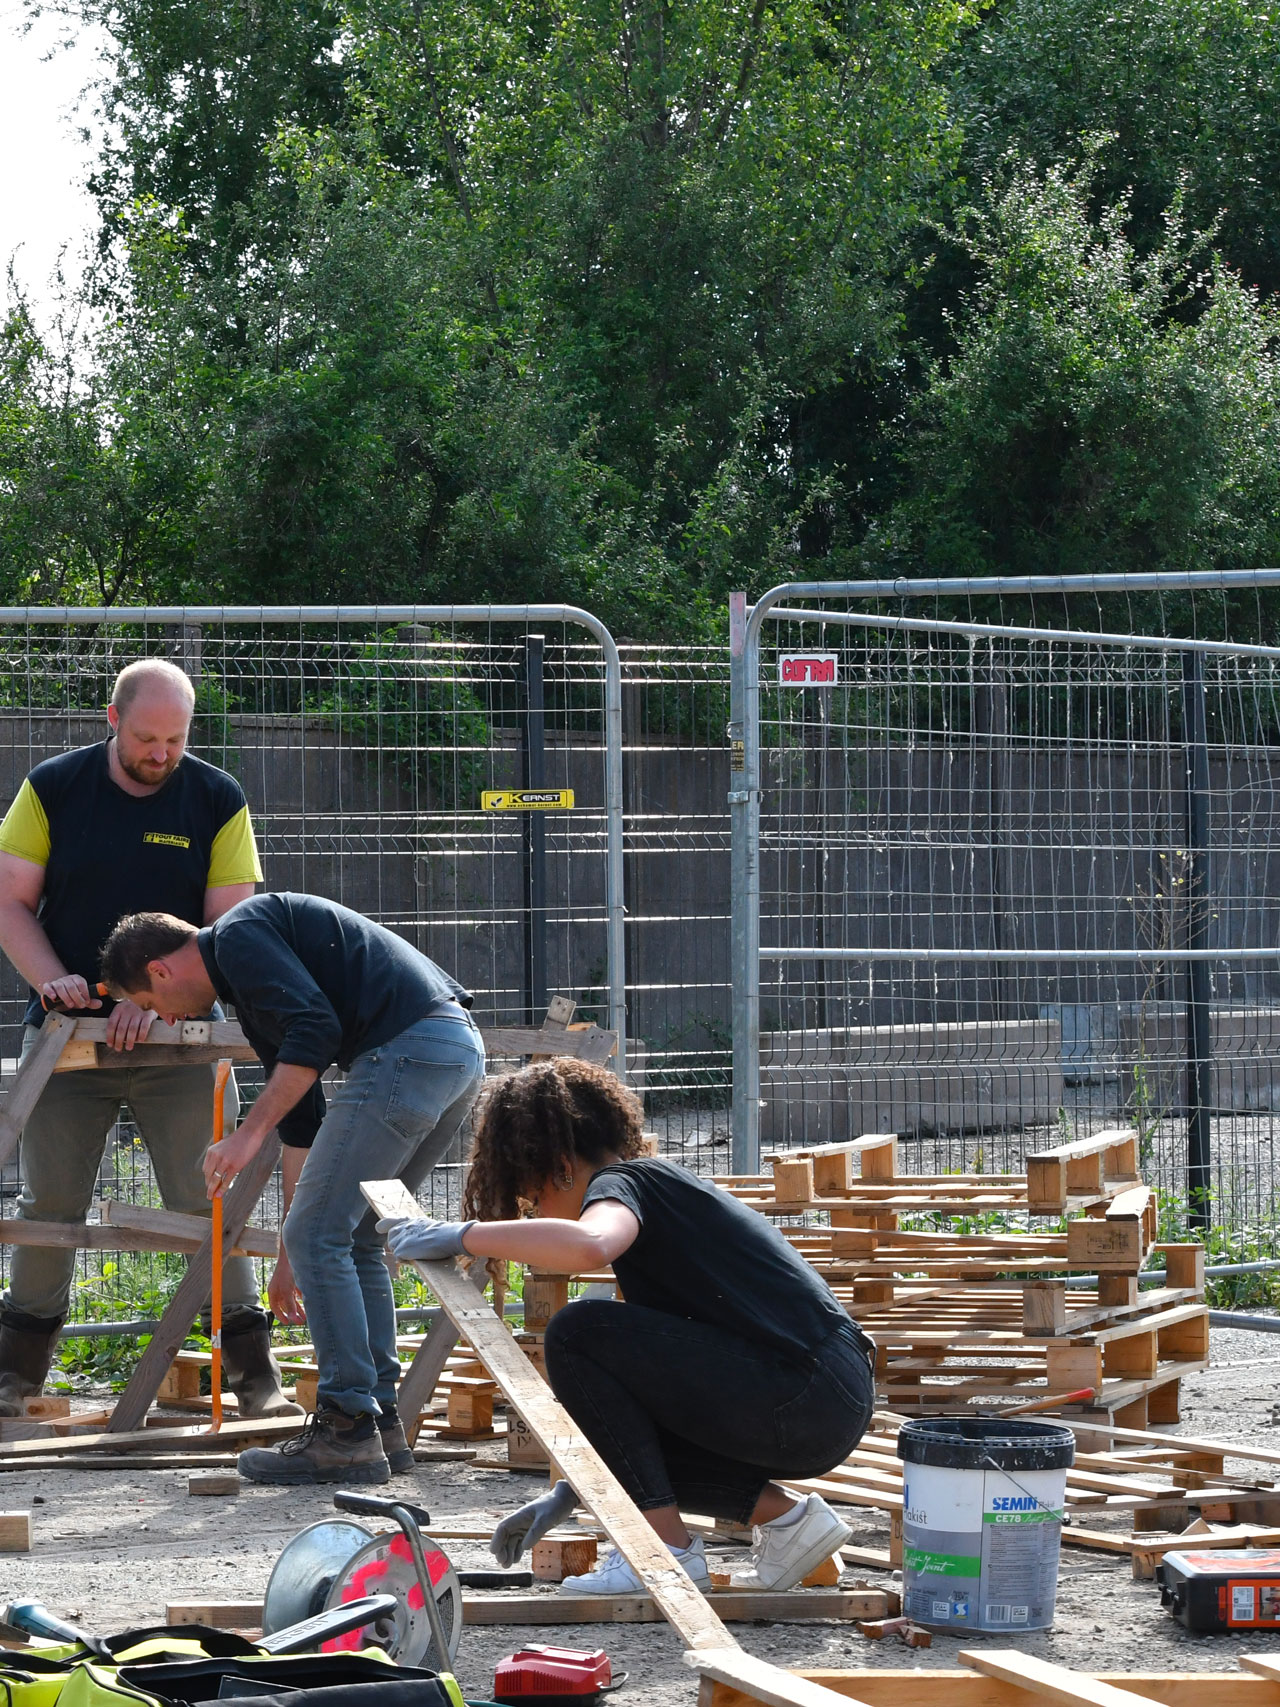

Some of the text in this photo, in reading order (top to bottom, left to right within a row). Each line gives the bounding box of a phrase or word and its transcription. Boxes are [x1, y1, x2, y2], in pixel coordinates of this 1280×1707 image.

[782, 659, 834, 682] COFRA
[510, 793, 560, 802] KERNST
[992, 1497, 1037, 1511] SEMIN
[996, 1514, 1021, 1523] CE78
